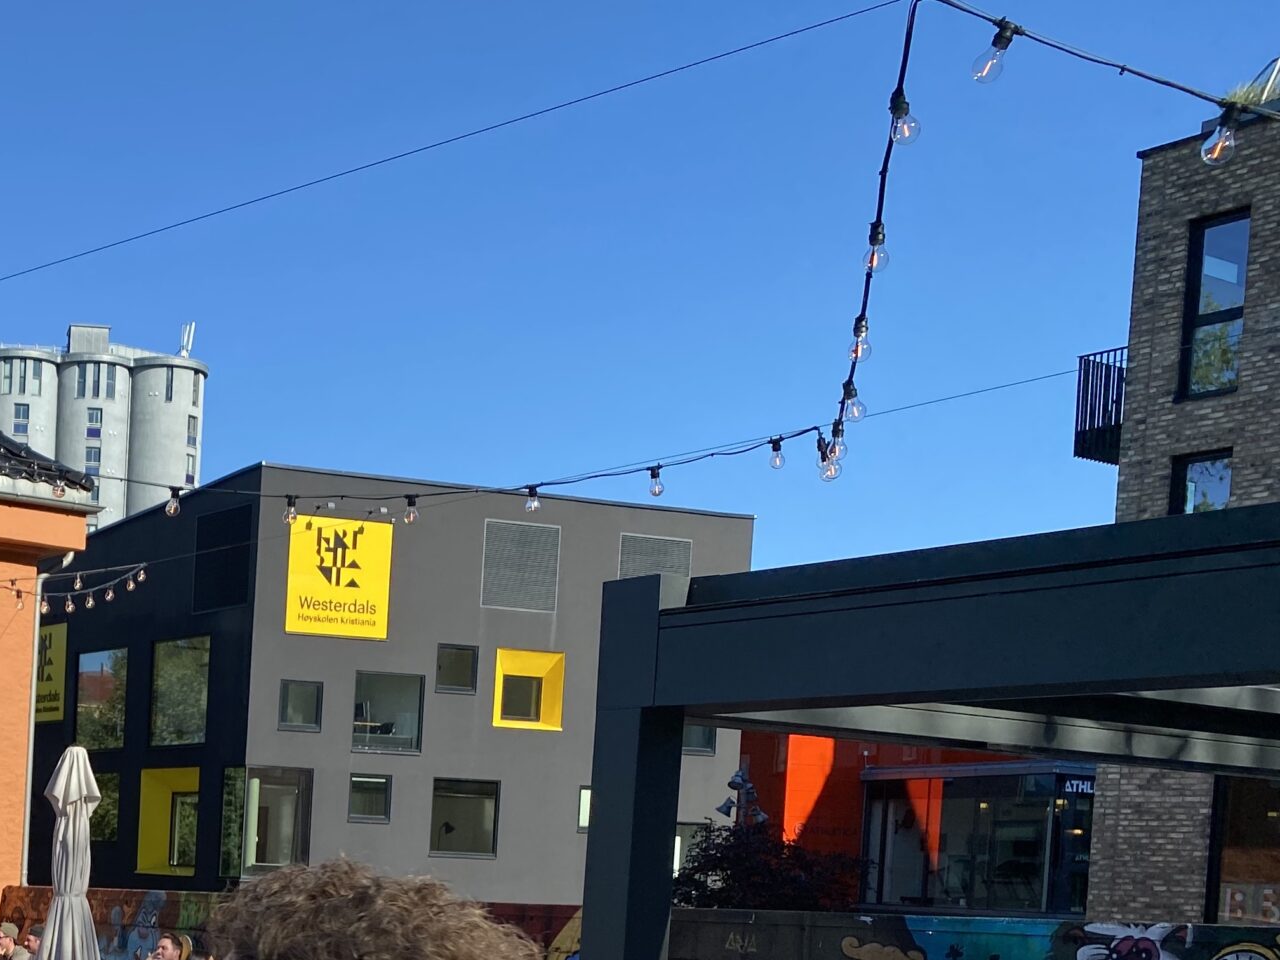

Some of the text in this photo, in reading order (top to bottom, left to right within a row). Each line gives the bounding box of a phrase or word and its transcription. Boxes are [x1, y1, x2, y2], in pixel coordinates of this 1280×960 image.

[299, 596, 377, 615] Westerdals
[297, 613, 376, 627] Høyskolen Kristiania
[1065, 780, 1096, 794] ATHL
